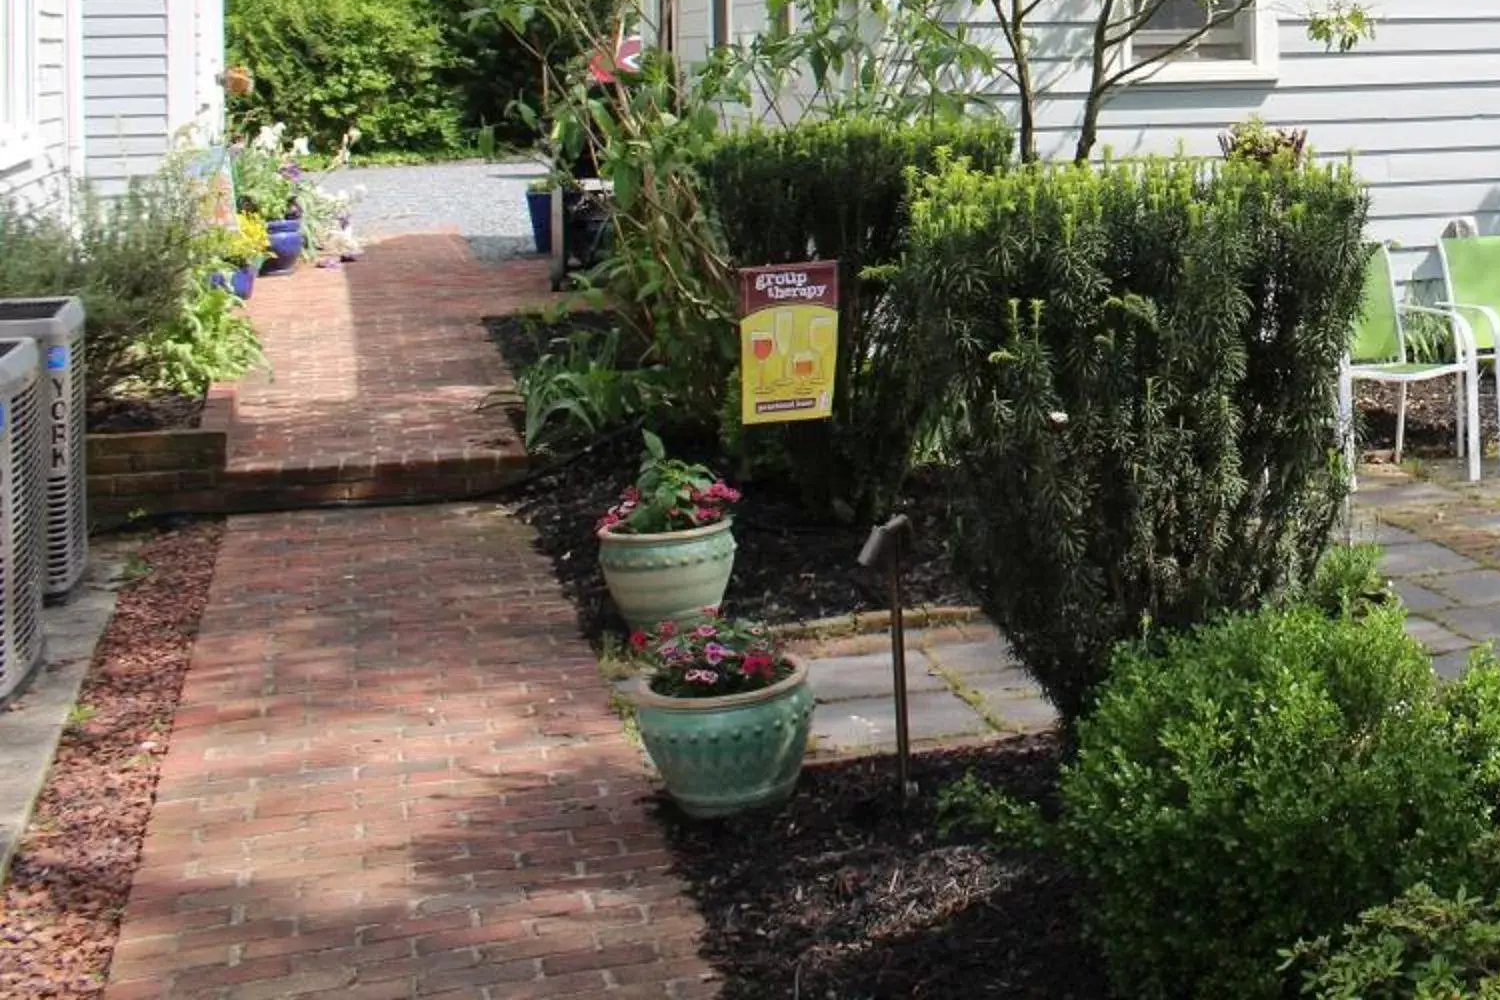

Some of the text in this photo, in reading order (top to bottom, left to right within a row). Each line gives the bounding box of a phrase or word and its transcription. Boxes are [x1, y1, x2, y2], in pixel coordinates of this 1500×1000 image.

[756, 272, 807, 291] group
[767, 284, 827, 300] therapy
[51, 378, 65, 468] YORK
